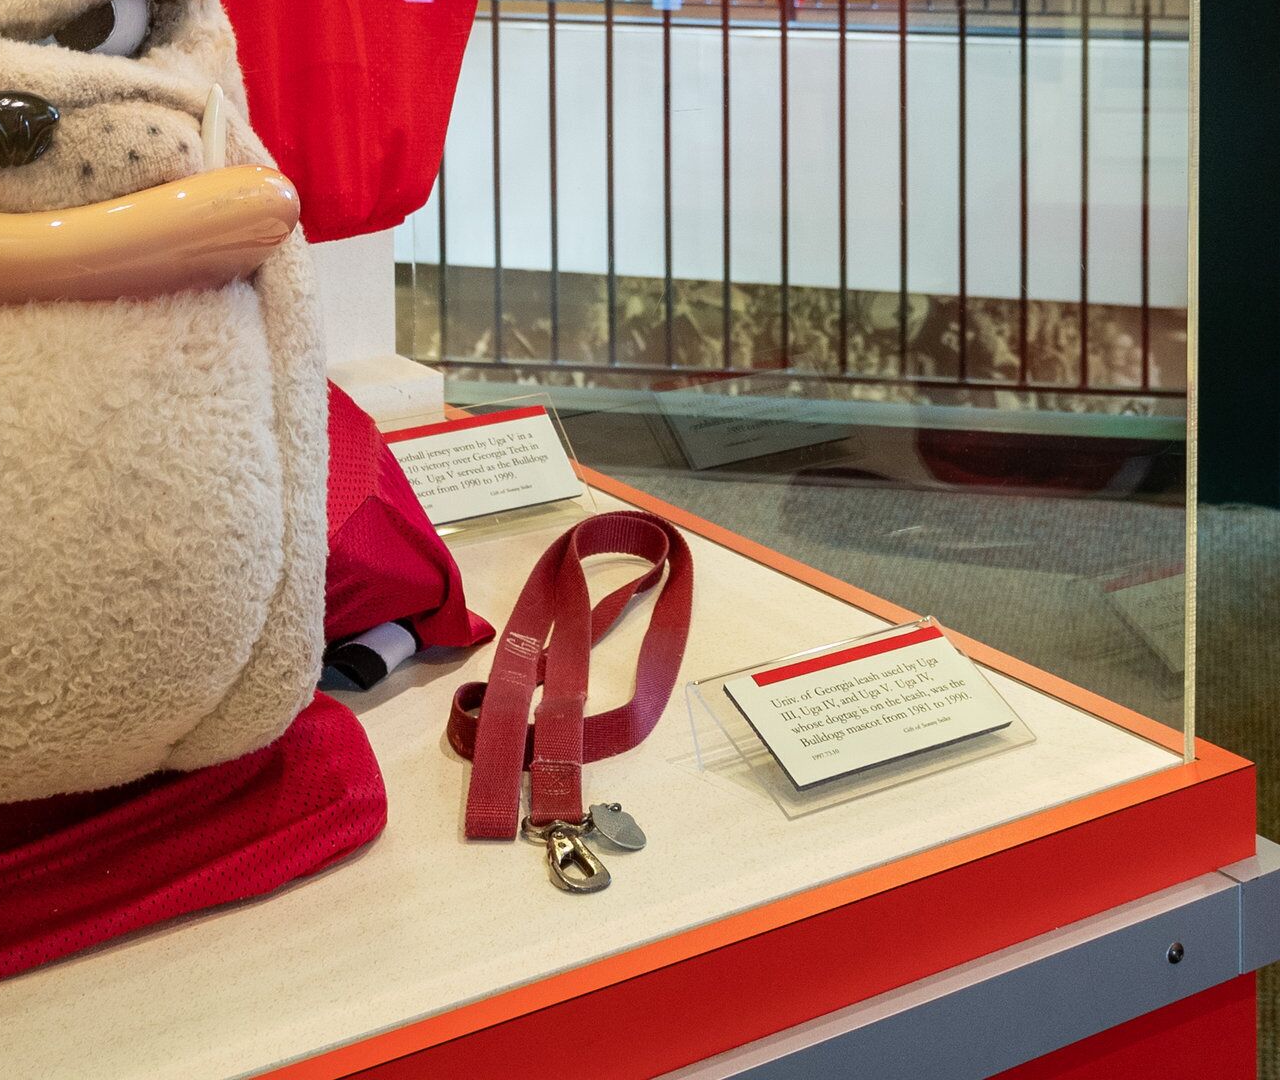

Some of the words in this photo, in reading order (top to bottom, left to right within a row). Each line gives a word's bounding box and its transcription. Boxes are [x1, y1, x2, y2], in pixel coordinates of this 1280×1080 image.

[398, 449, 425, 463] ootball
[427, 446, 451, 461] jersey
[453, 444, 475, 453] worn
[476, 439, 487, 450] by
[488, 436, 507, 448] Uga
[505, 434, 514, 443] V
[517, 433, 527, 441] in
[421, 457, 450, 471] victory
[452, 457, 471, 466] over
[473, 449, 507, 463] Georgia
[508, 446, 528, 457] Tech
[529, 443, 539, 451] in
[426, 473, 446, 485] Uga
[447, 470, 456, 479] V
[457, 466, 485, 477] served
[487, 464, 496, 472] as
[497, 461, 511, 470] the
[512, 453, 549, 467] Bulldogs
[417, 487, 435, 498] scot
[437, 482, 459, 494] from
[460, 478, 481, 490] 1990
[484, 475, 492, 484] to
[494, 471, 517, 484] 1999.
[771, 695, 800, 709] Univ.
[800, 689, 812, 700] of
[814, 680, 854, 697] Georgia
[855, 671, 881, 685] leash
[881, 664, 904, 678] used
[904, 662, 917, 674] by
[916, 656, 938, 670] Uga
[781, 709, 801, 723] III,
[800, 704, 823, 718] Uga
[822, 698, 840, 710] IV,
[841, 692, 859, 705] and
[860, 687, 881, 702] Uga
[880, 683, 893, 693] V.
[895, 675, 917, 690] Uga
[916, 671, 934, 683] IV,
[791, 720, 824, 736] whose
[825, 709, 860, 726] dogtag
[860, 705, 869, 714] is
[870, 702, 883, 712] on
[885, 694, 903, 708] the
[903, 688, 931, 703] leash,
[932, 683, 949, 694] was
[949, 678, 966, 689] the
[800, 730, 845, 748] Bulldogs
[847, 720, 882, 734] mascot
[882, 712, 908, 724] from
[908, 703, 932, 716] 1981
[934, 701, 945, 709] to
[946, 692, 972, 706] 1990.
